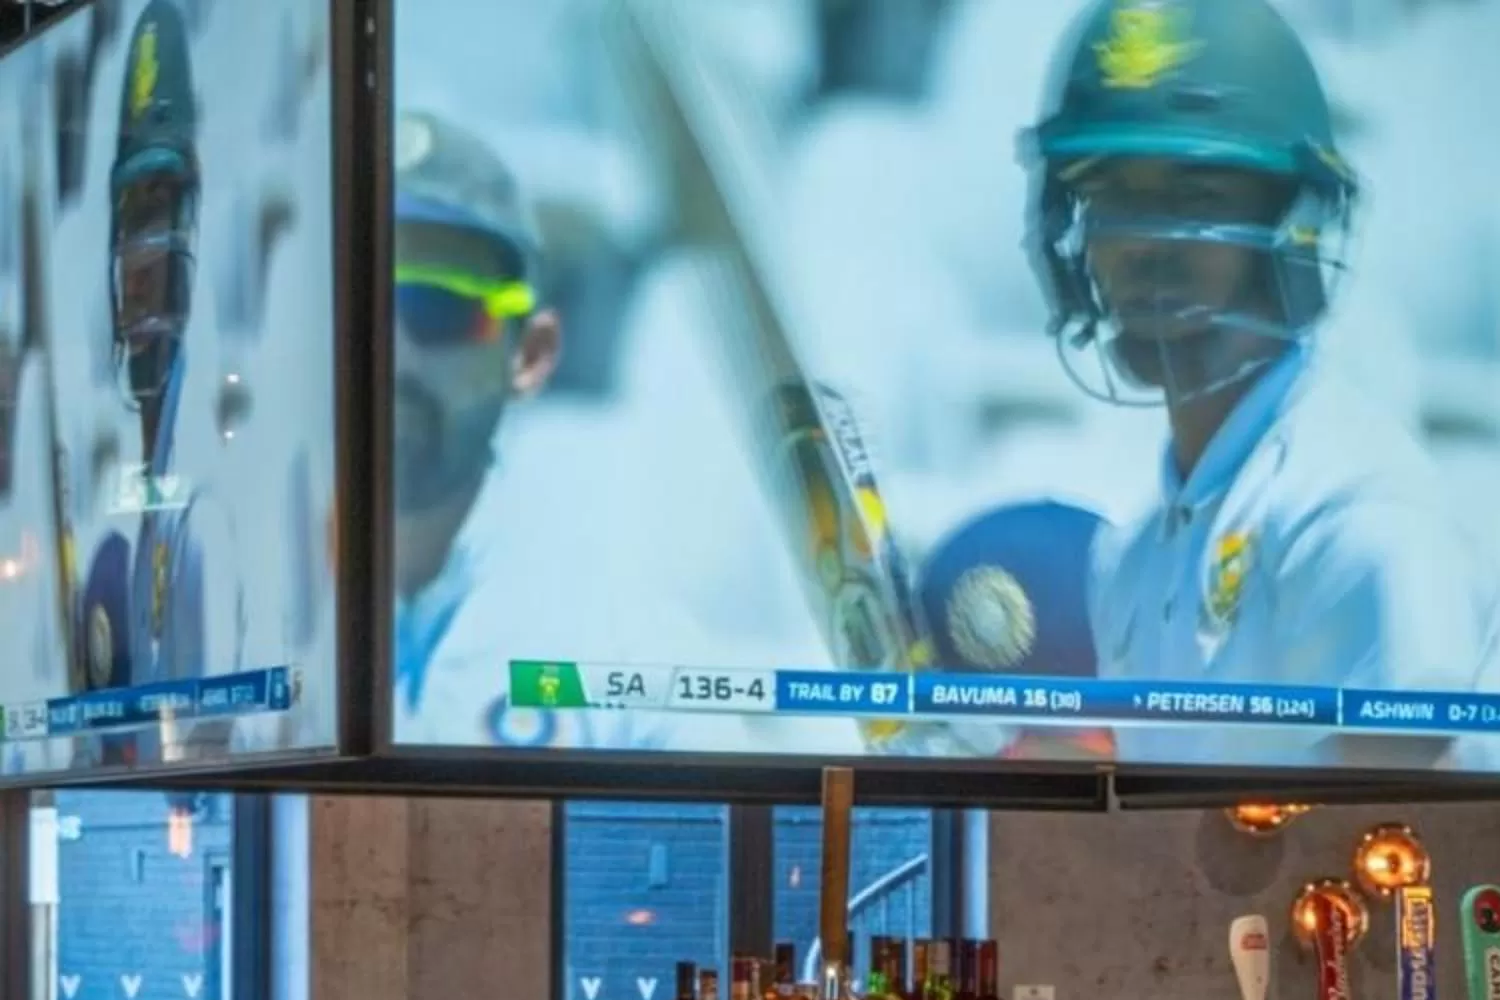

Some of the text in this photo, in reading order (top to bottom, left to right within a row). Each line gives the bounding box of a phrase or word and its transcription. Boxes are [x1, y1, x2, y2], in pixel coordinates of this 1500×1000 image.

[606, 671, 646, 697] SA
[678, 675, 766, 701] 136-4
[787, 682, 899, 705] TRAIL BY 87
[931, 684, 1017, 706] BAVUMA
[1147, 691, 1245, 713] PETERSEN
[1248, 694, 1273, 715] 56
[1359, 699, 1436, 721] ASHWIN
